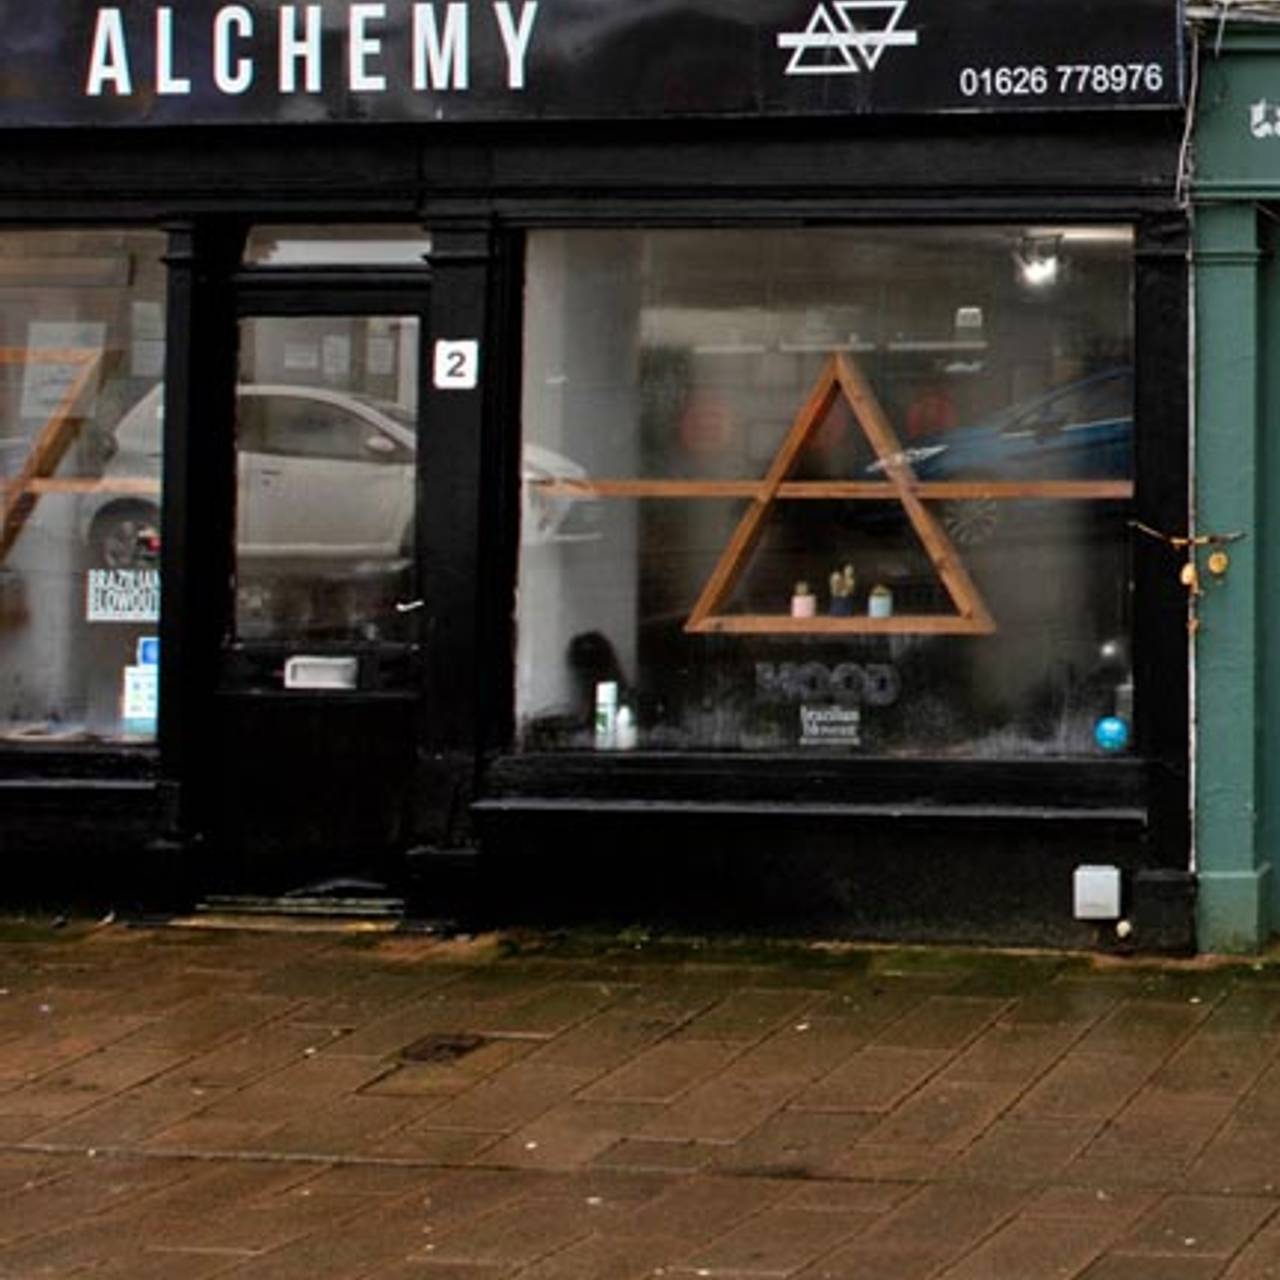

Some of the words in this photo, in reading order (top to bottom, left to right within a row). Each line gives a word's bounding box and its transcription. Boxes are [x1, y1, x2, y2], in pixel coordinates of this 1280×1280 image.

[86, 0, 539, 97] ALCHEMY
[959, 66, 1049, 97] 01626
[1056, 63, 1164, 94] 778976
[446, 350, 467, 378] 2
